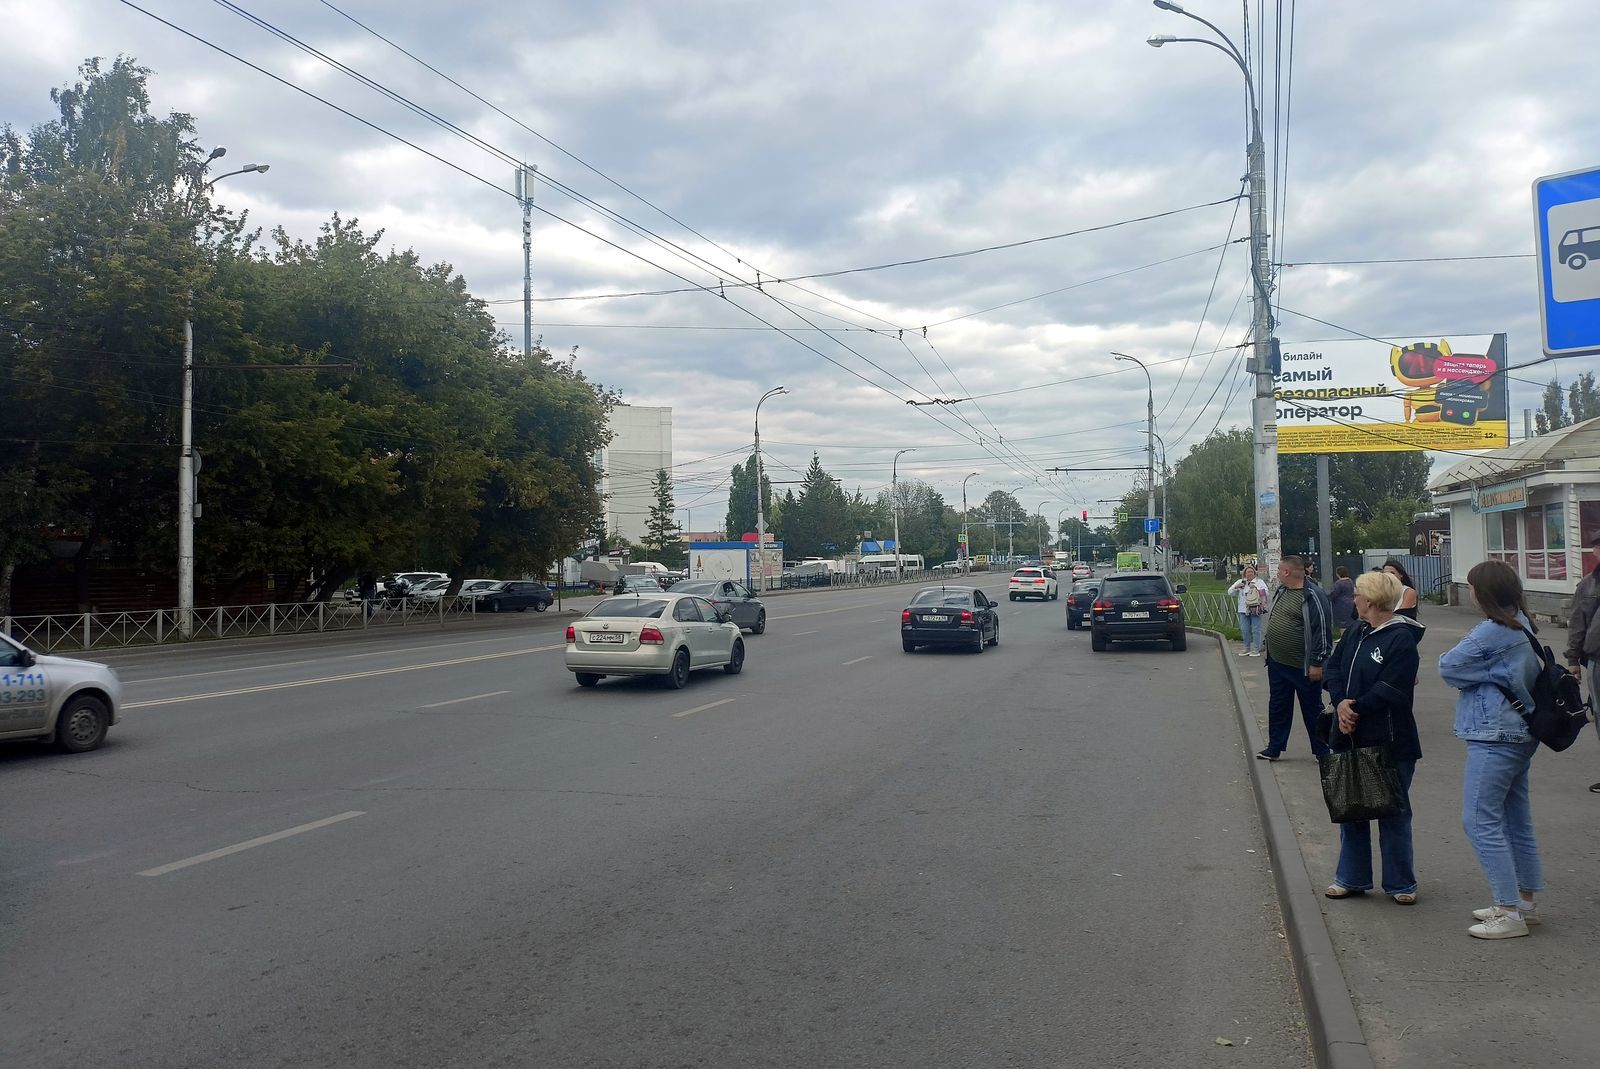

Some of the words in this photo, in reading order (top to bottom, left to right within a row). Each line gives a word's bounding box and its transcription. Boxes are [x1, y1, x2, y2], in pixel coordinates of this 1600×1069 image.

[1283, 352, 1322, 362] билайн
[1272, 367, 1332, 384] самый
[1272, 383, 1387, 399] безопасный
[1276, 405, 1363, 422] оператор
[0, 688, 45, 704] 3-293
